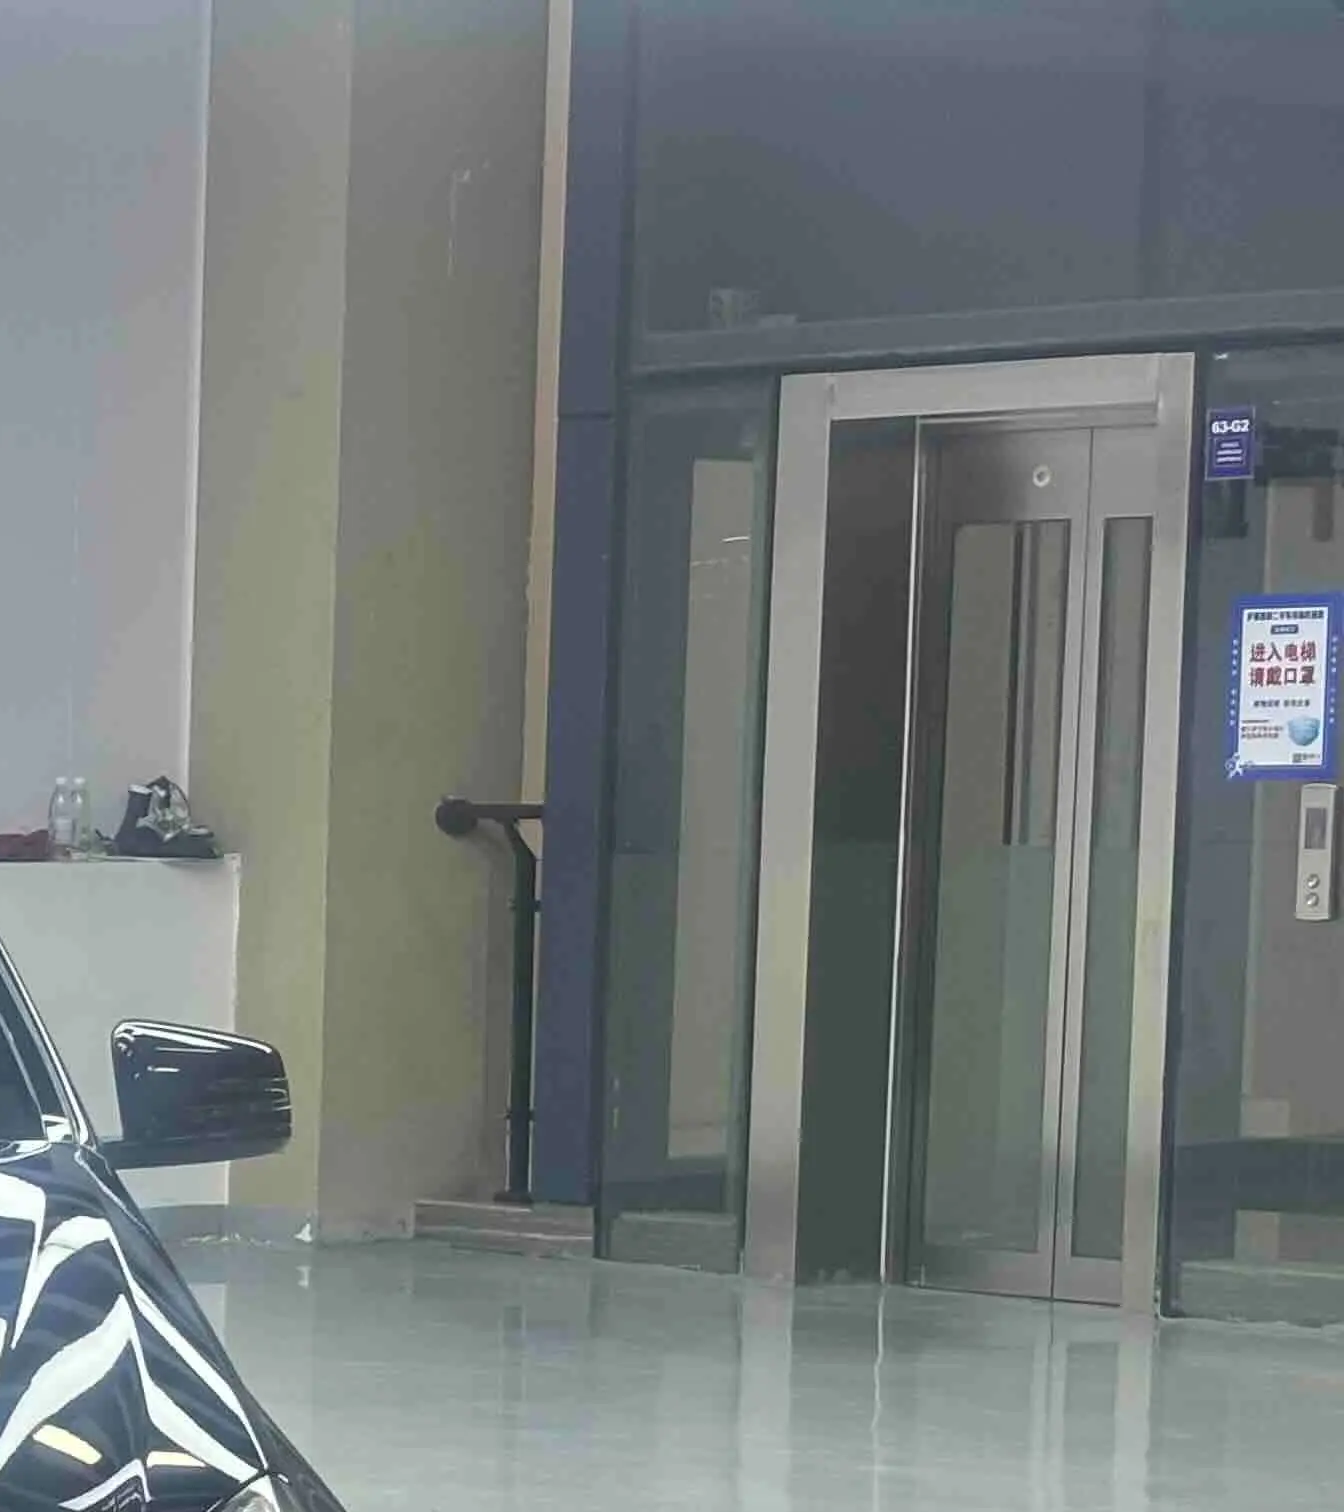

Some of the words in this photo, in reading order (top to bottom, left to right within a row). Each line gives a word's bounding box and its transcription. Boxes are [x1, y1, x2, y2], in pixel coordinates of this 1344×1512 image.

[1249, 640, 1317, 662] 进入电梯
[1249, 665, 1316, 688] 请戴口罩
